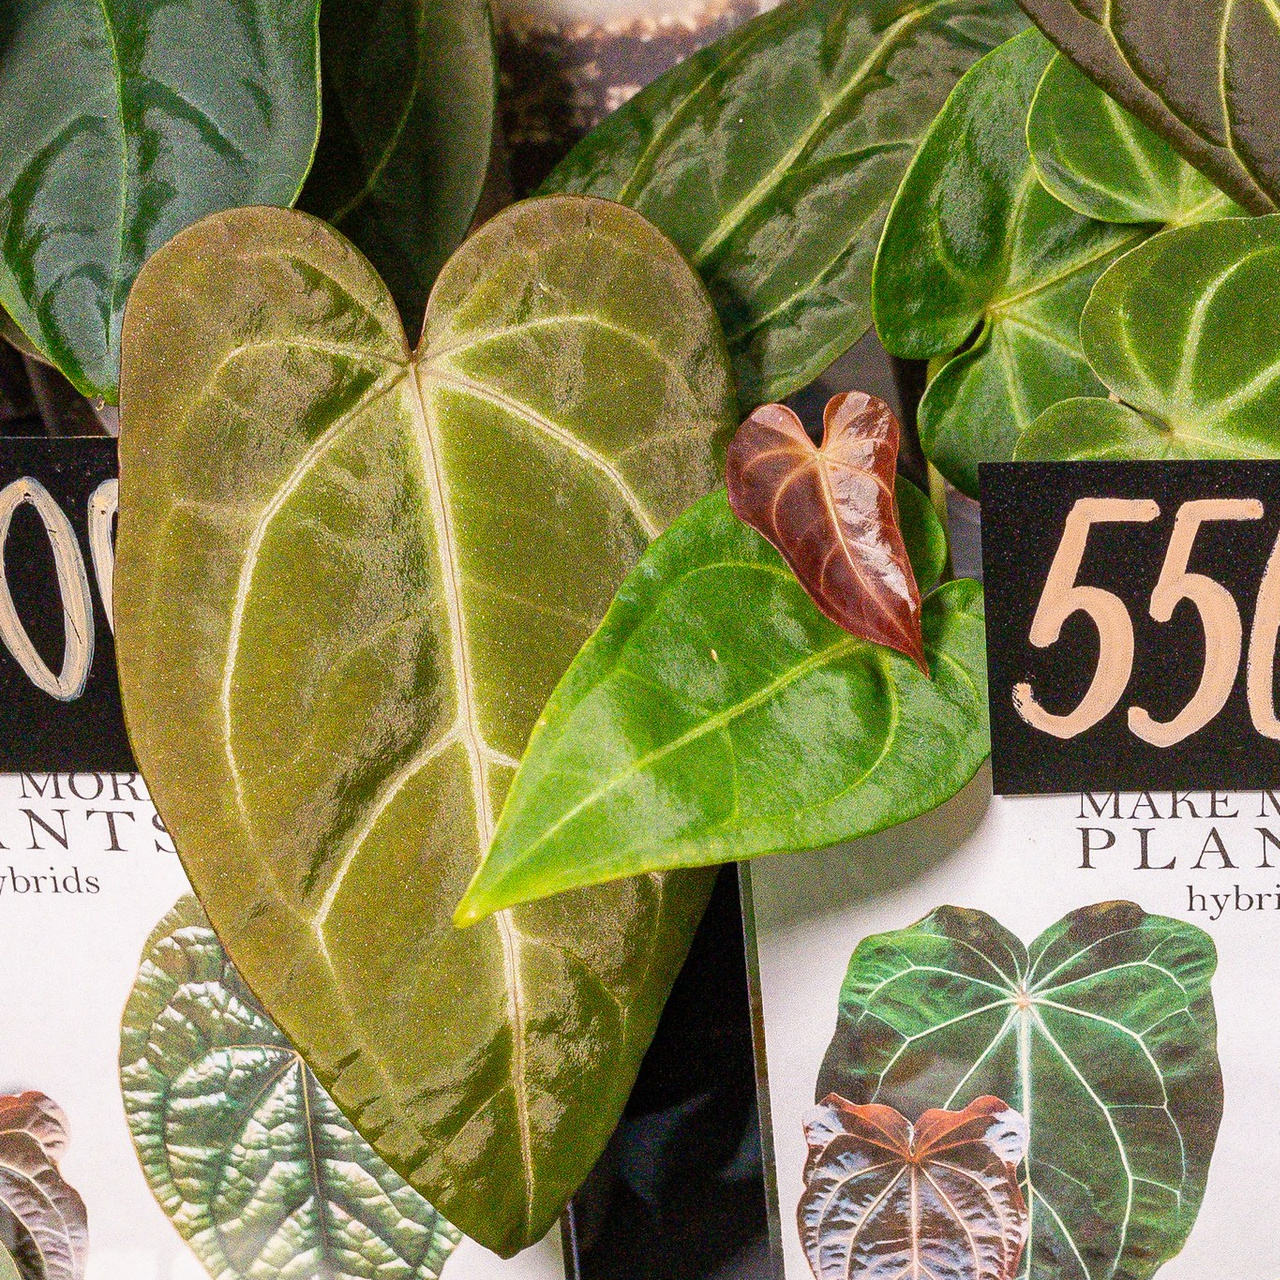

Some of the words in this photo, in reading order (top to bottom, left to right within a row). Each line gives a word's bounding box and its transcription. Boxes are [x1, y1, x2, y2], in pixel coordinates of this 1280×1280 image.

[18, 772, 153, 802] MOR
[1076, 788, 1241, 821] MAKE
[0, 866, 101, 895] brids
